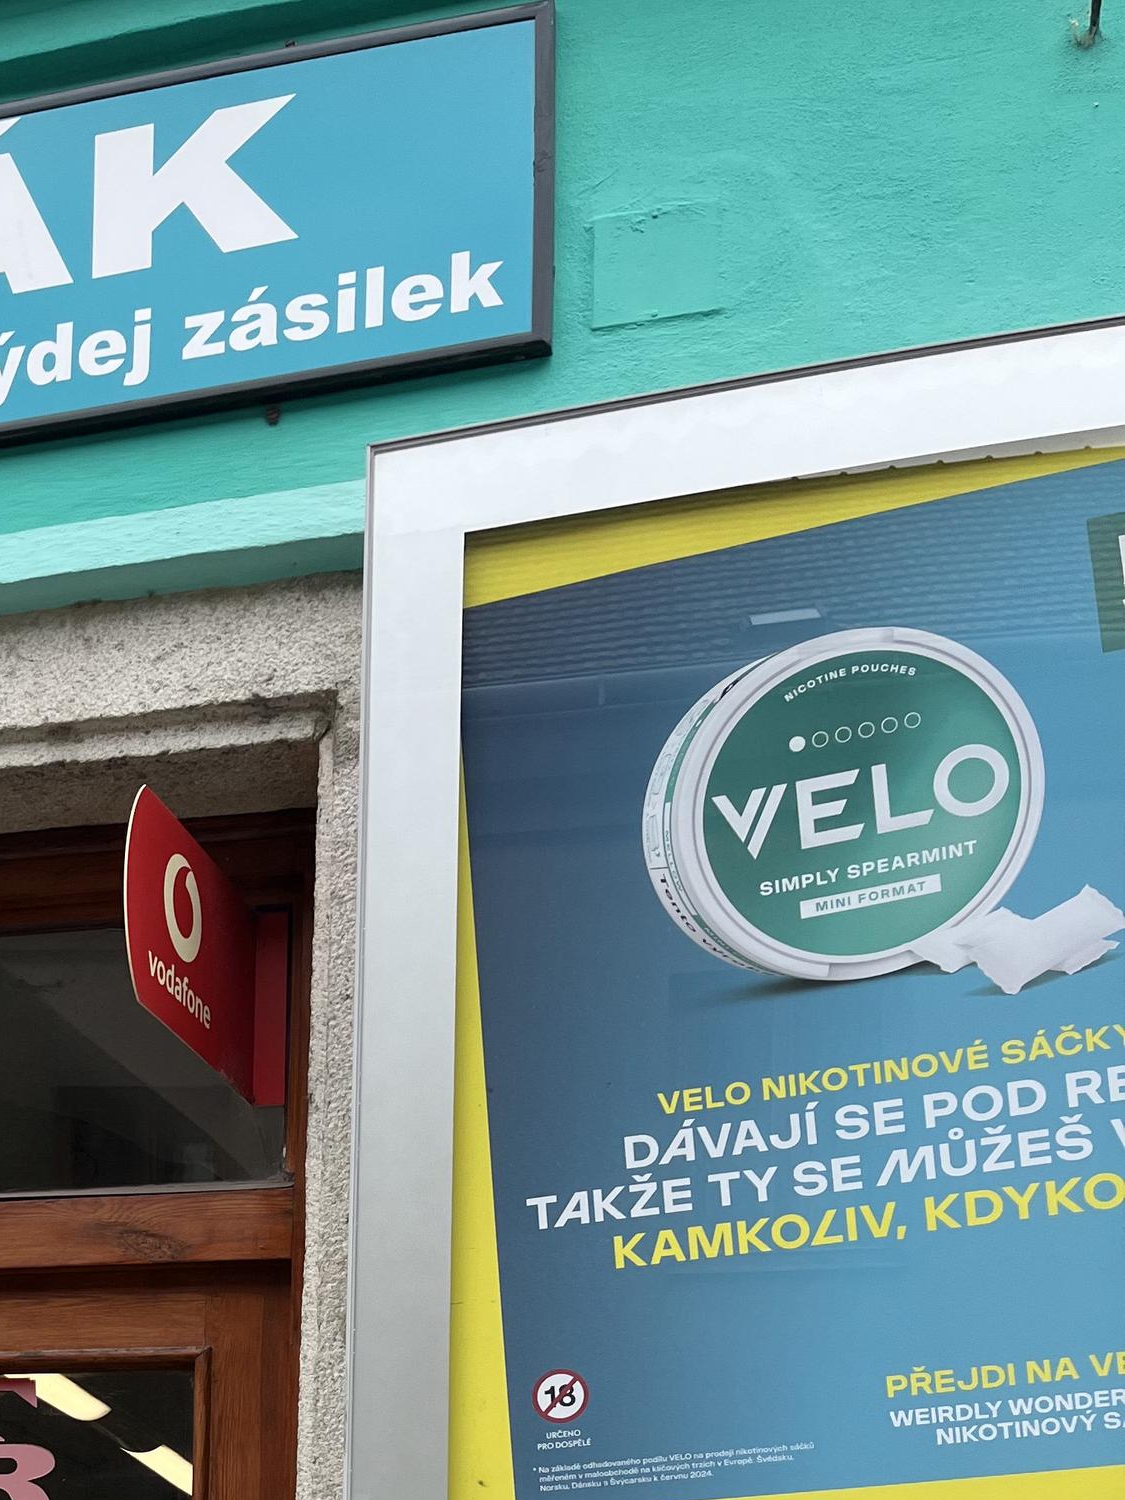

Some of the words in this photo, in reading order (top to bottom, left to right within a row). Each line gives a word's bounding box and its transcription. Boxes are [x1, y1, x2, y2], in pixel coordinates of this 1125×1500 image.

[183, 251, 504, 359] zásilek
[783, 666, 848, 703] NICOTINE
[850, 663, 917, 677] POUCHES
[711, 744, 1009, 859] VELO
[759, 866, 839, 897] SIMPLY
[846, 839, 978, 879] SPEARMINT
[814, 895, 853, 913] MINI
[857, 880, 927, 905] FORMAT
[148, 950, 211, 1030] vodafone
[657, 1082, 749, 1115] VELO
[761, 1040, 989, 1103] NIKOTINOVÉ
[624, 1104, 818, 1170] DÁVAJÍ
[835, 1098, 904, 1138] SE
[924, 1080, 1047, 1129] POD
[527, 1174, 693, 1230] TAKŽE
[708, 1167, 778, 1206] TY
[793, 1155, 863, 1197] SE
[876, 1113, 1094, 1187] MŮŽEŠ
[612, 1201, 908, 1269] KAMKOLIV,
[924, 1172, 1125, 1231] KDYKO
[544, 1384, 576, 1408] 18
[886, 1363, 1016, 1398] PŘEJDI
[1026, 1356, 1080, 1384] NA
[889, 1400, 1003, 1428] WEIRDLY
[1008, 1389, 1125, 1416] WONDER
[936, 1410, 1097, 1446] NIKOTINOVÝ
[537, 1442, 554, 1451] PRO
[555, 1438, 591, 1449] DOSPĚLÉ
[546, 1429, 581, 1439] URČENO
